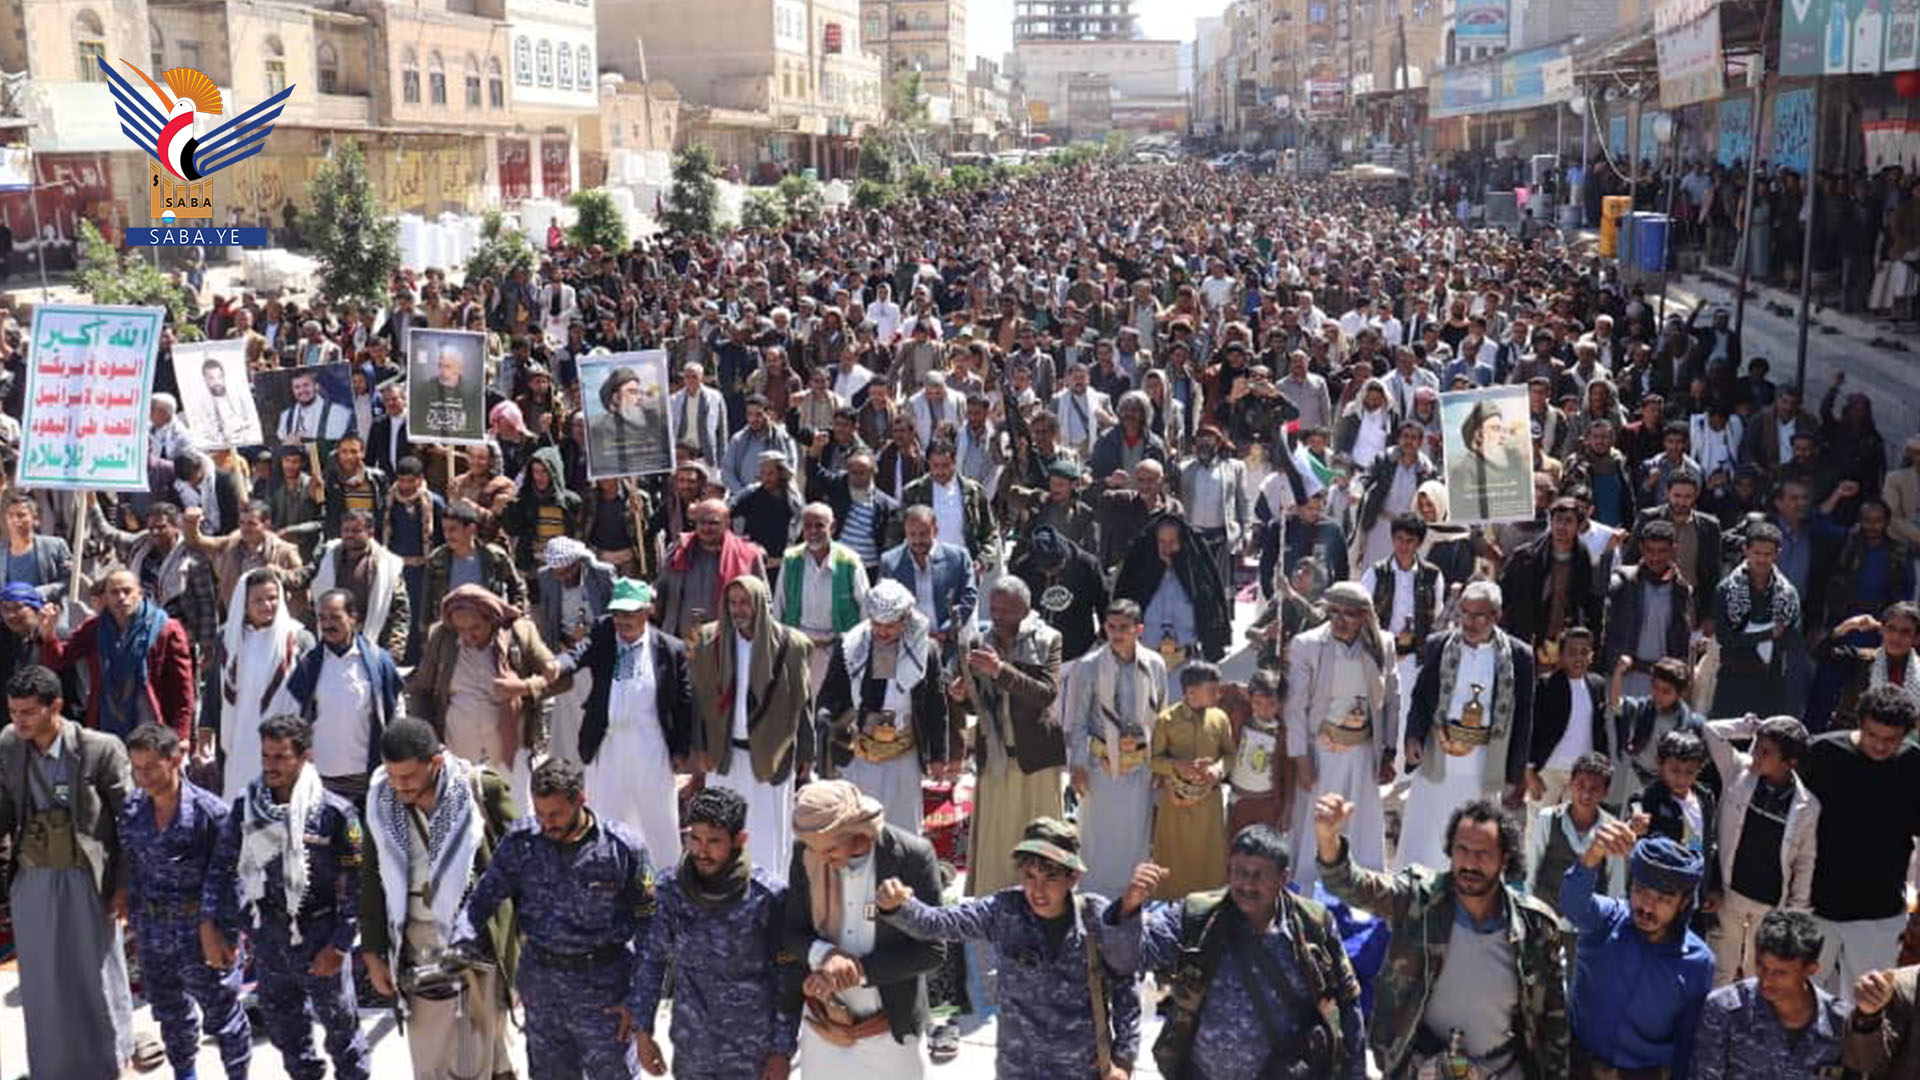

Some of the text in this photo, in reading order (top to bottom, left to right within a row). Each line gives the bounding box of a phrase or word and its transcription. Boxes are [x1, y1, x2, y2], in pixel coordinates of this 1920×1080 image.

[108, 320, 148, 347] الله
[99, 358, 144, 380] الموت
[96, 387, 140, 409] الموت
[32, 415, 137, 439] اللعنة على اليهود
[87, 442, 136, 475] النصر
